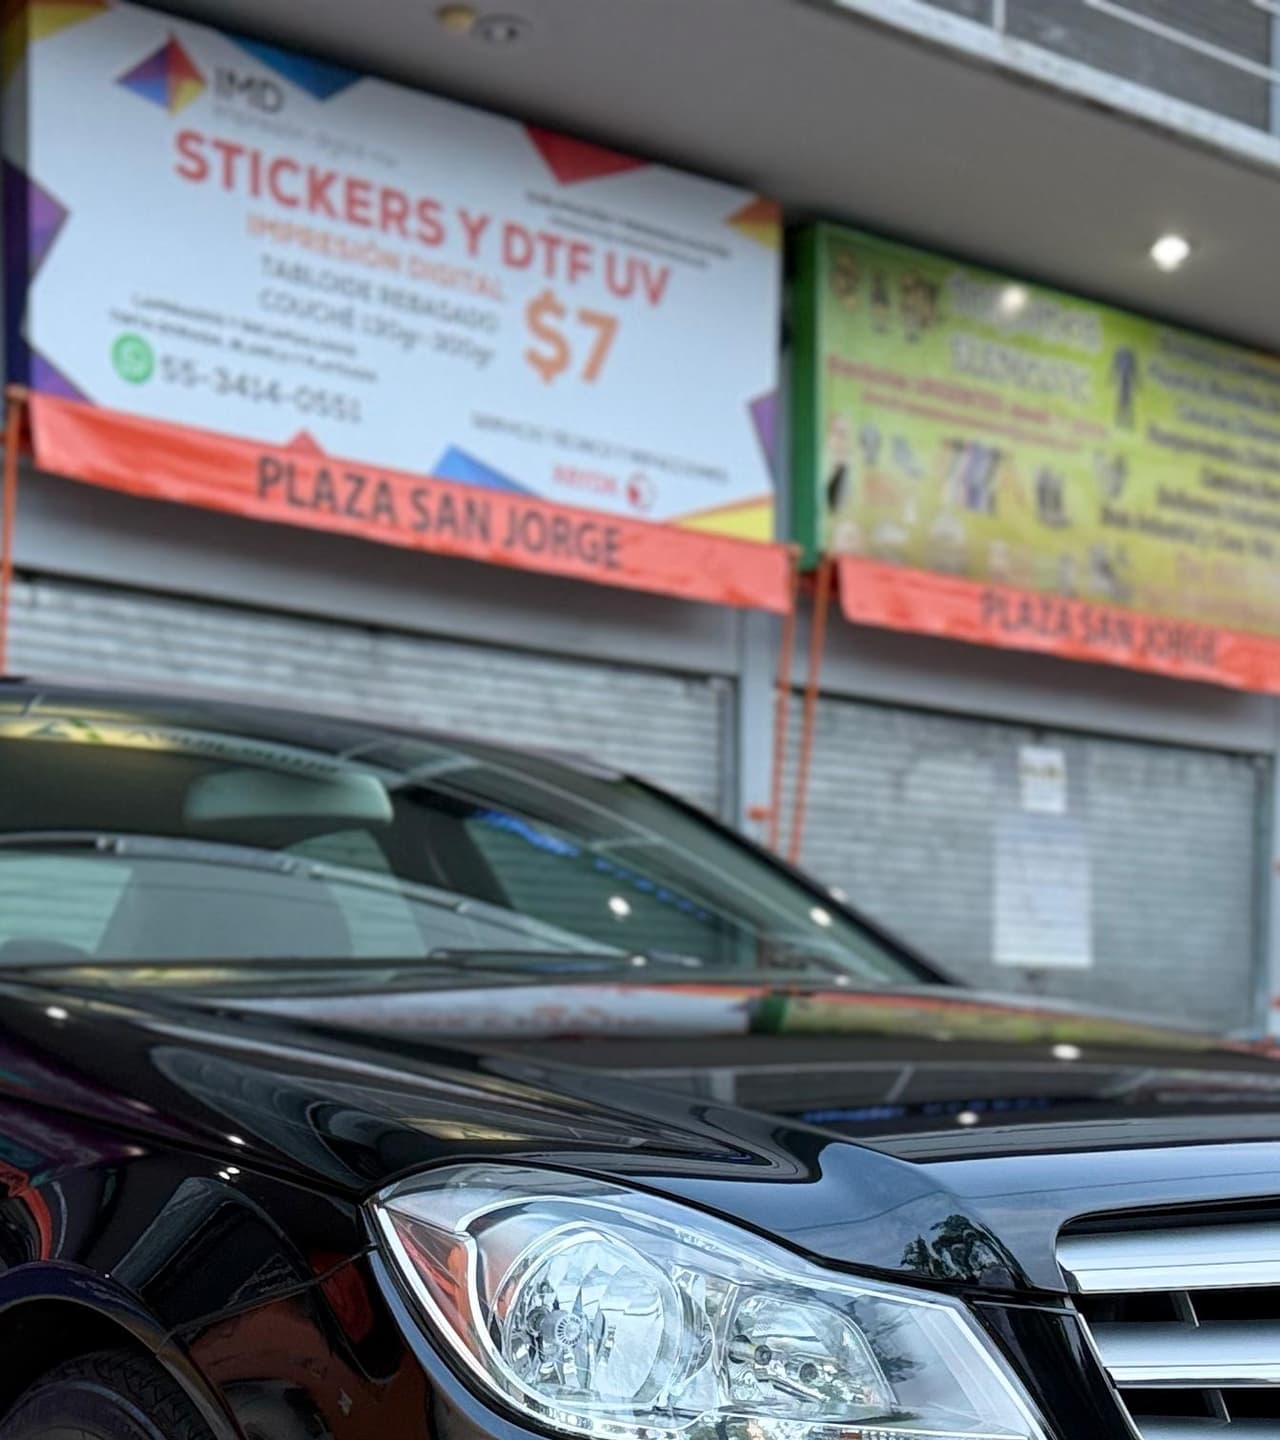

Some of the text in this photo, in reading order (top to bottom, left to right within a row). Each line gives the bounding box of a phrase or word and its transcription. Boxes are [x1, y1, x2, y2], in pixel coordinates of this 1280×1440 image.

[174, 128, 446, 249] STICKERS
[456, 206, 490, 258] Y
[501, 220, 595, 286] DTF
[604, 250, 672, 308] UV
[524, 286, 619, 386] $7
[256, 455, 623, 571] PLAZA SAN JORGE
[980, 591, 1218, 667] PLAZA SAN JORGE
